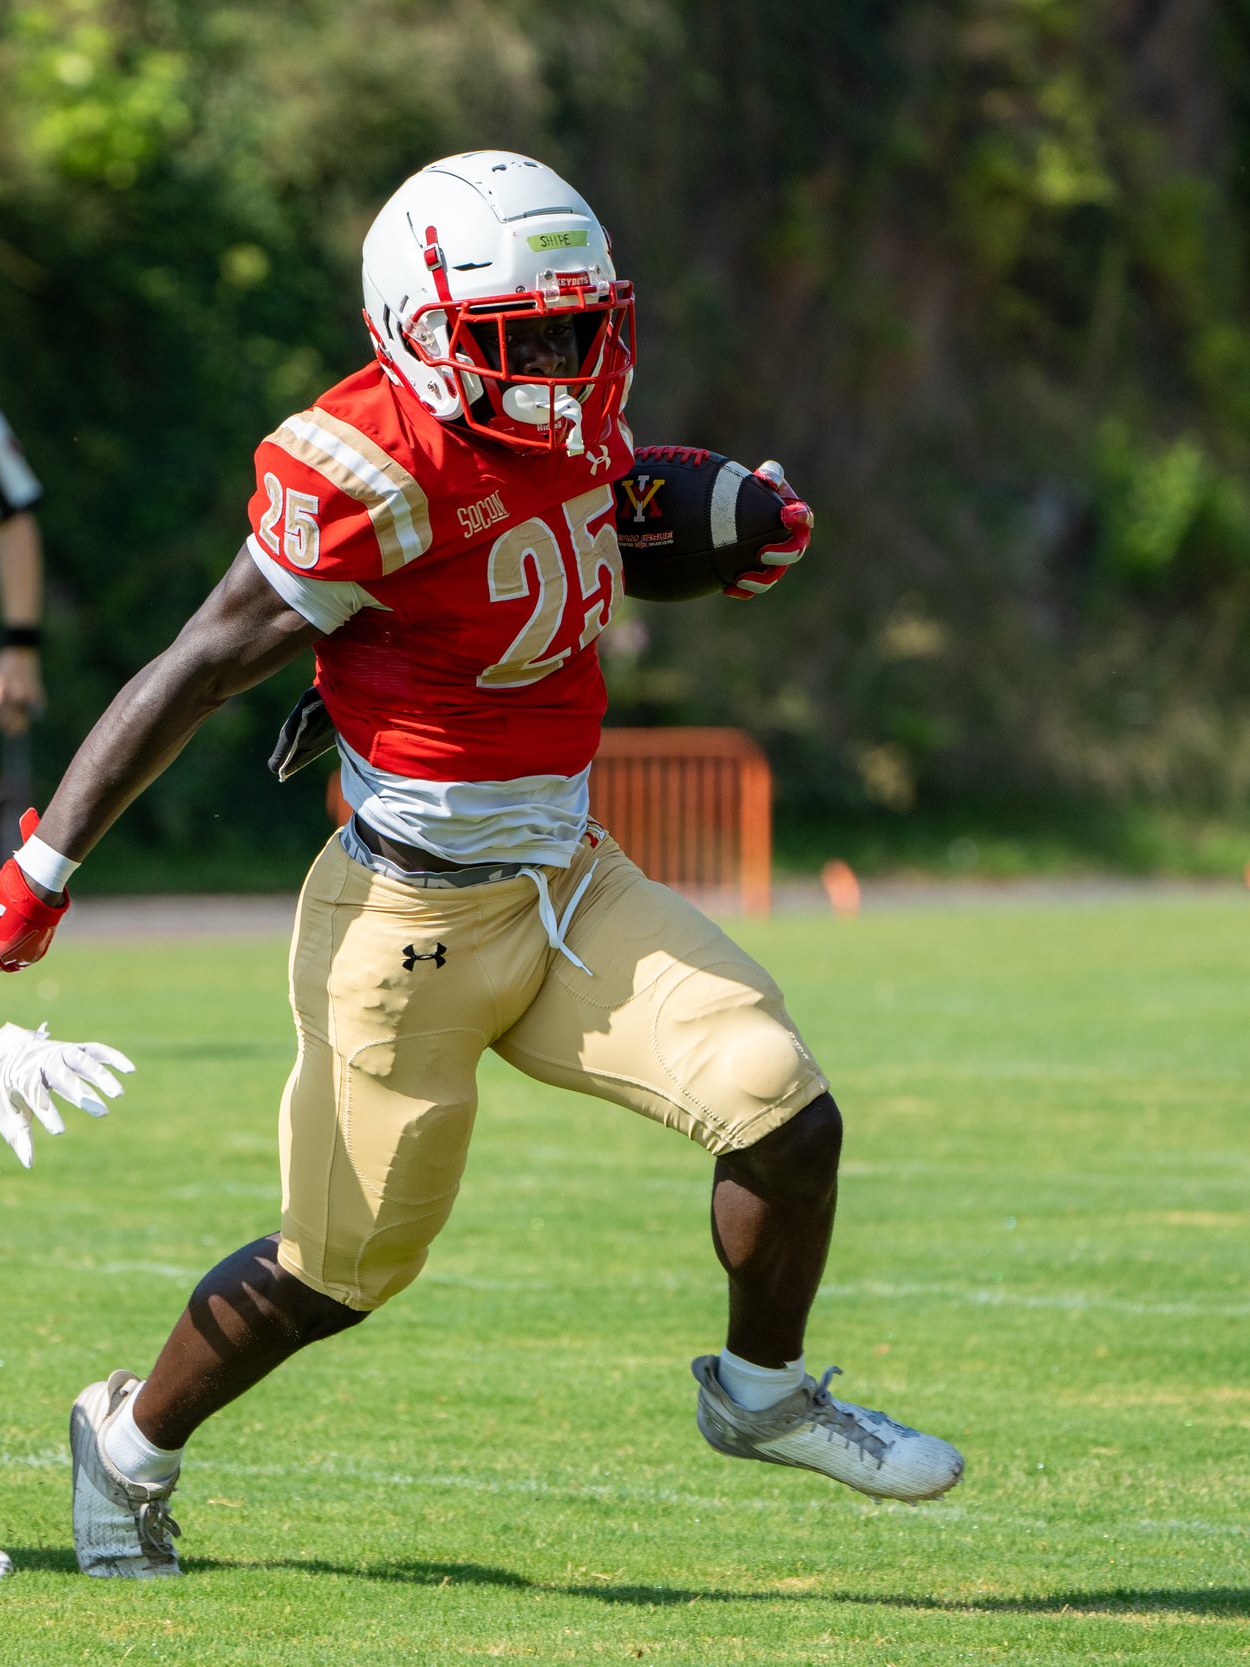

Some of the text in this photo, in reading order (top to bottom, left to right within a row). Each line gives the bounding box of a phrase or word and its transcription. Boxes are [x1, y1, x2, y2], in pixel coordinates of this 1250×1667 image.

[539, 233, 571, 248] SHIPE
[258, 471, 320, 570] 25
[476, 483, 625, 688] 25
